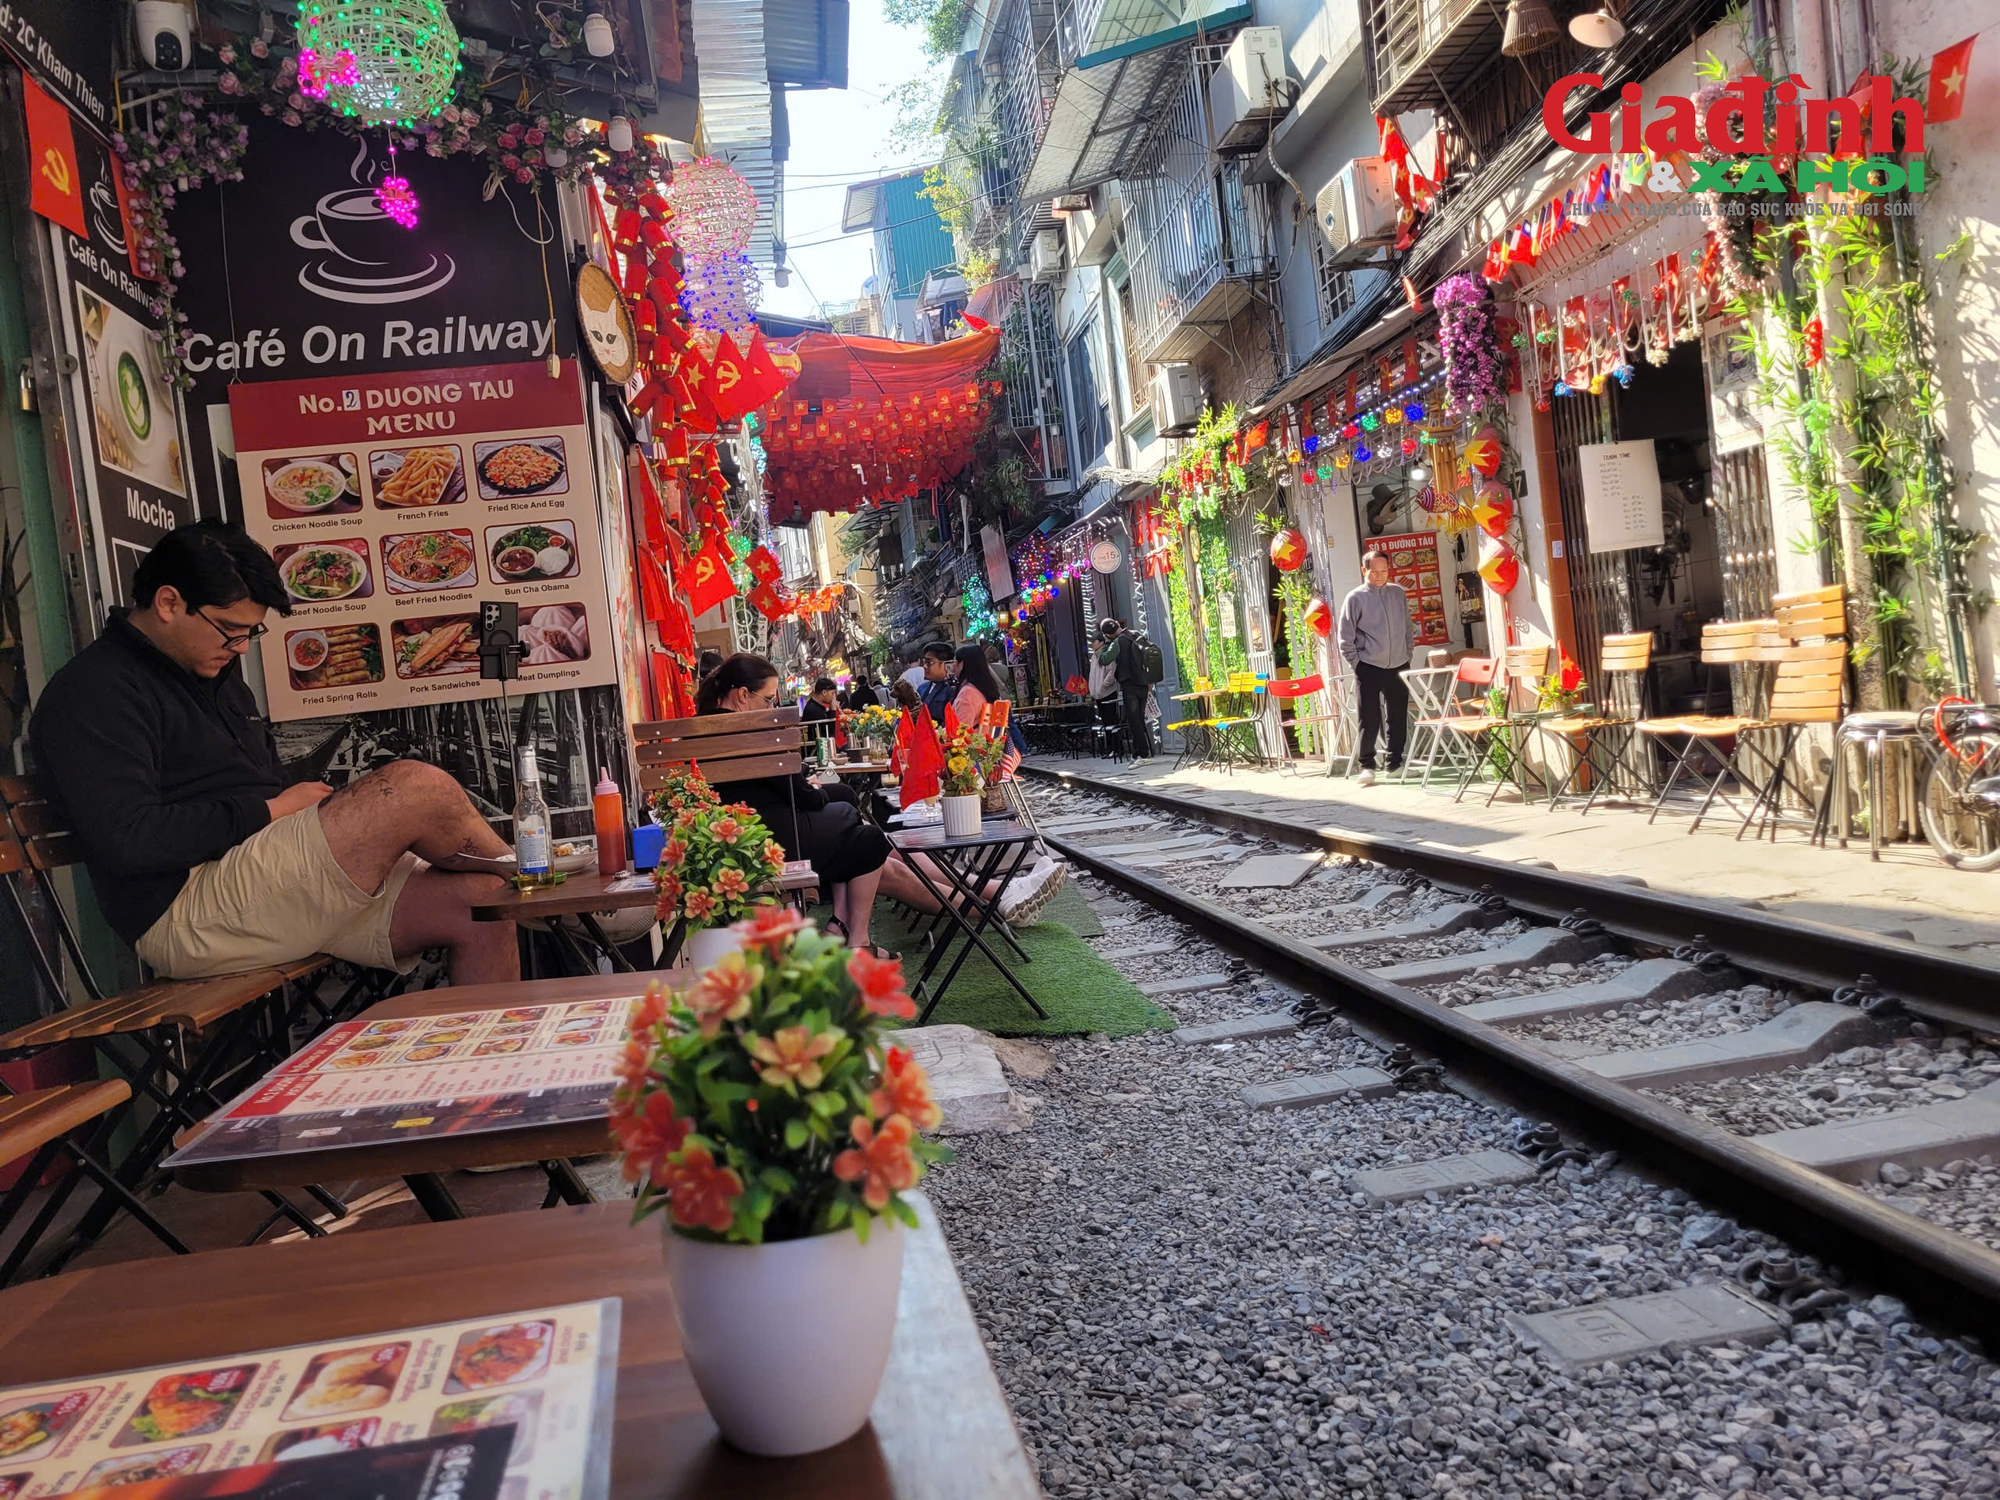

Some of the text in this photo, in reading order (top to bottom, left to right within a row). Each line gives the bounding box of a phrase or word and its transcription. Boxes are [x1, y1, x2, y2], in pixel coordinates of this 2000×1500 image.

[16, 16, 35, 52] 2C
[37, 36, 73, 89] Kham
[75, 72, 105, 122] Thien
[69, 234, 98, 273] Café
[100, 257, 118, 287] On
[182, 315, 557, 373] Café On Railway
[299, 379, 515, 414] No.2 DUONG TAU
[366, 410, 457, 436] MENU
[126, 487, 176, 532] Mocha
[488, 499, 565, 513] Fried Rice And Egg
[397, 509, 449, 521] French Fries
[272, 517, 363, 532] Chicken Noodle Soup
[1381, 542, 1387, 551] 9
[1389, 538, 1417, 550] ĐƯỜNG
[1418, 536, 1434, 546] TÀU
[1106, 551, 1116, 560] 15
[504, 583, 570, 596] Bun Cha Obama
[395, 592, 473, 606] Beef Fried Noodles
[291, 603, 367, 617] Beef Noodle Soup
[516, 669, 581, 683] Meat Dumplings
[410, 679, 481, 694] Pork Sandwiches
[302, 690, 378, 706] Fried Spring Rolls
[322, 1031, 352, 1046] MENU
